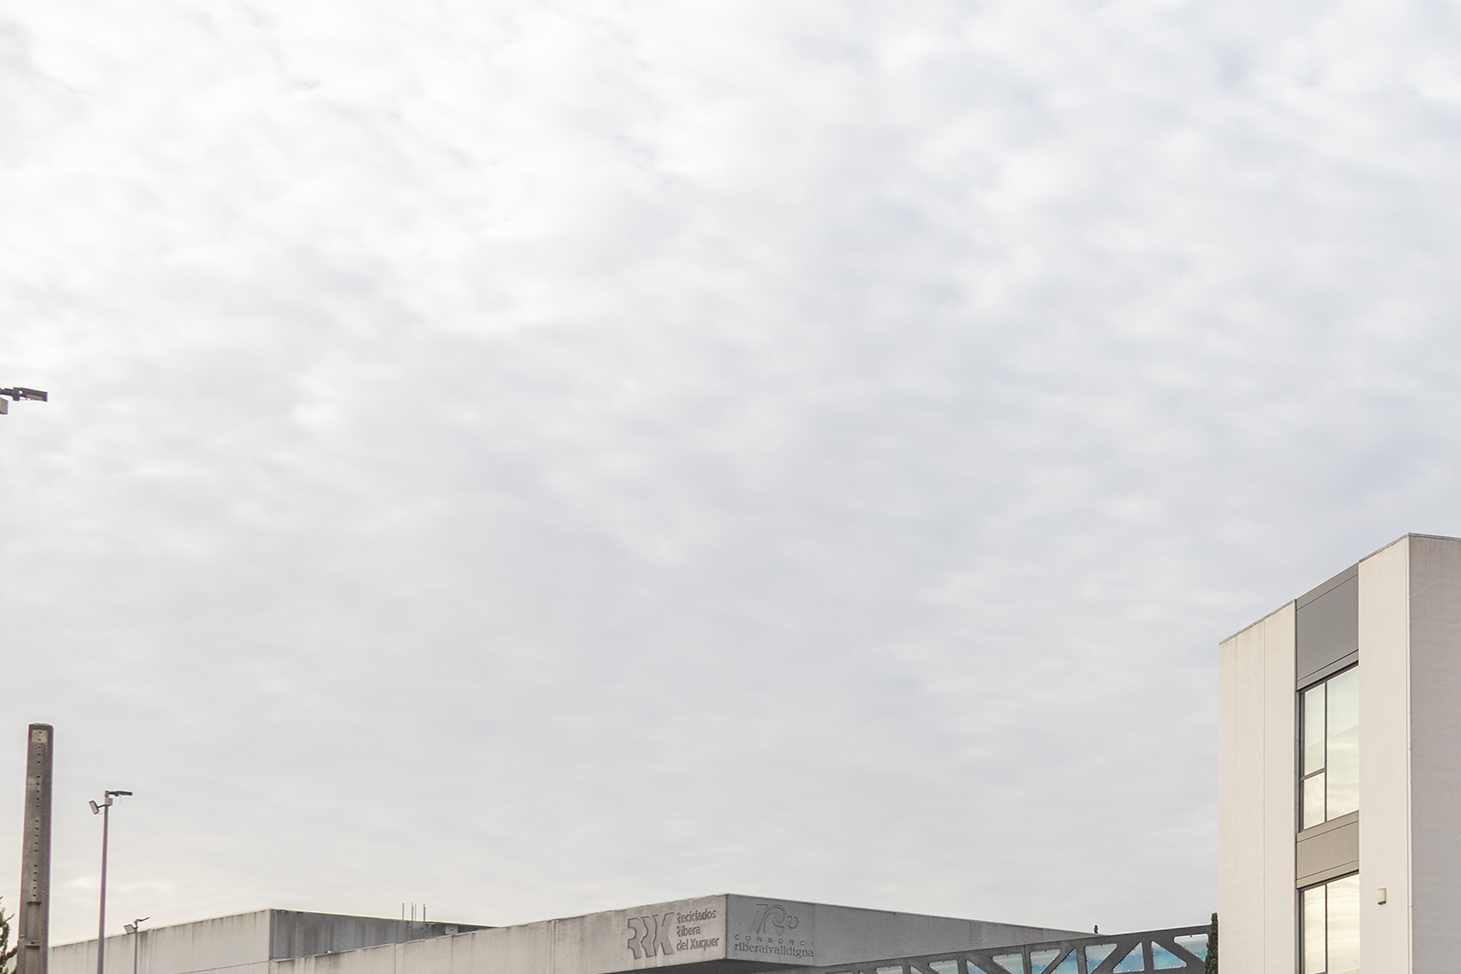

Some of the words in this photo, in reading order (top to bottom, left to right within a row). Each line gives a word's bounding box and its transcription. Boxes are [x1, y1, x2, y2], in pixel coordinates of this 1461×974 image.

[676, 908, 717, 923] Reciclados
[676, 925, 701, 937] Ribera
[676, 940, 689, 951] del
[734, 934, 814, 947] CONSORCI
